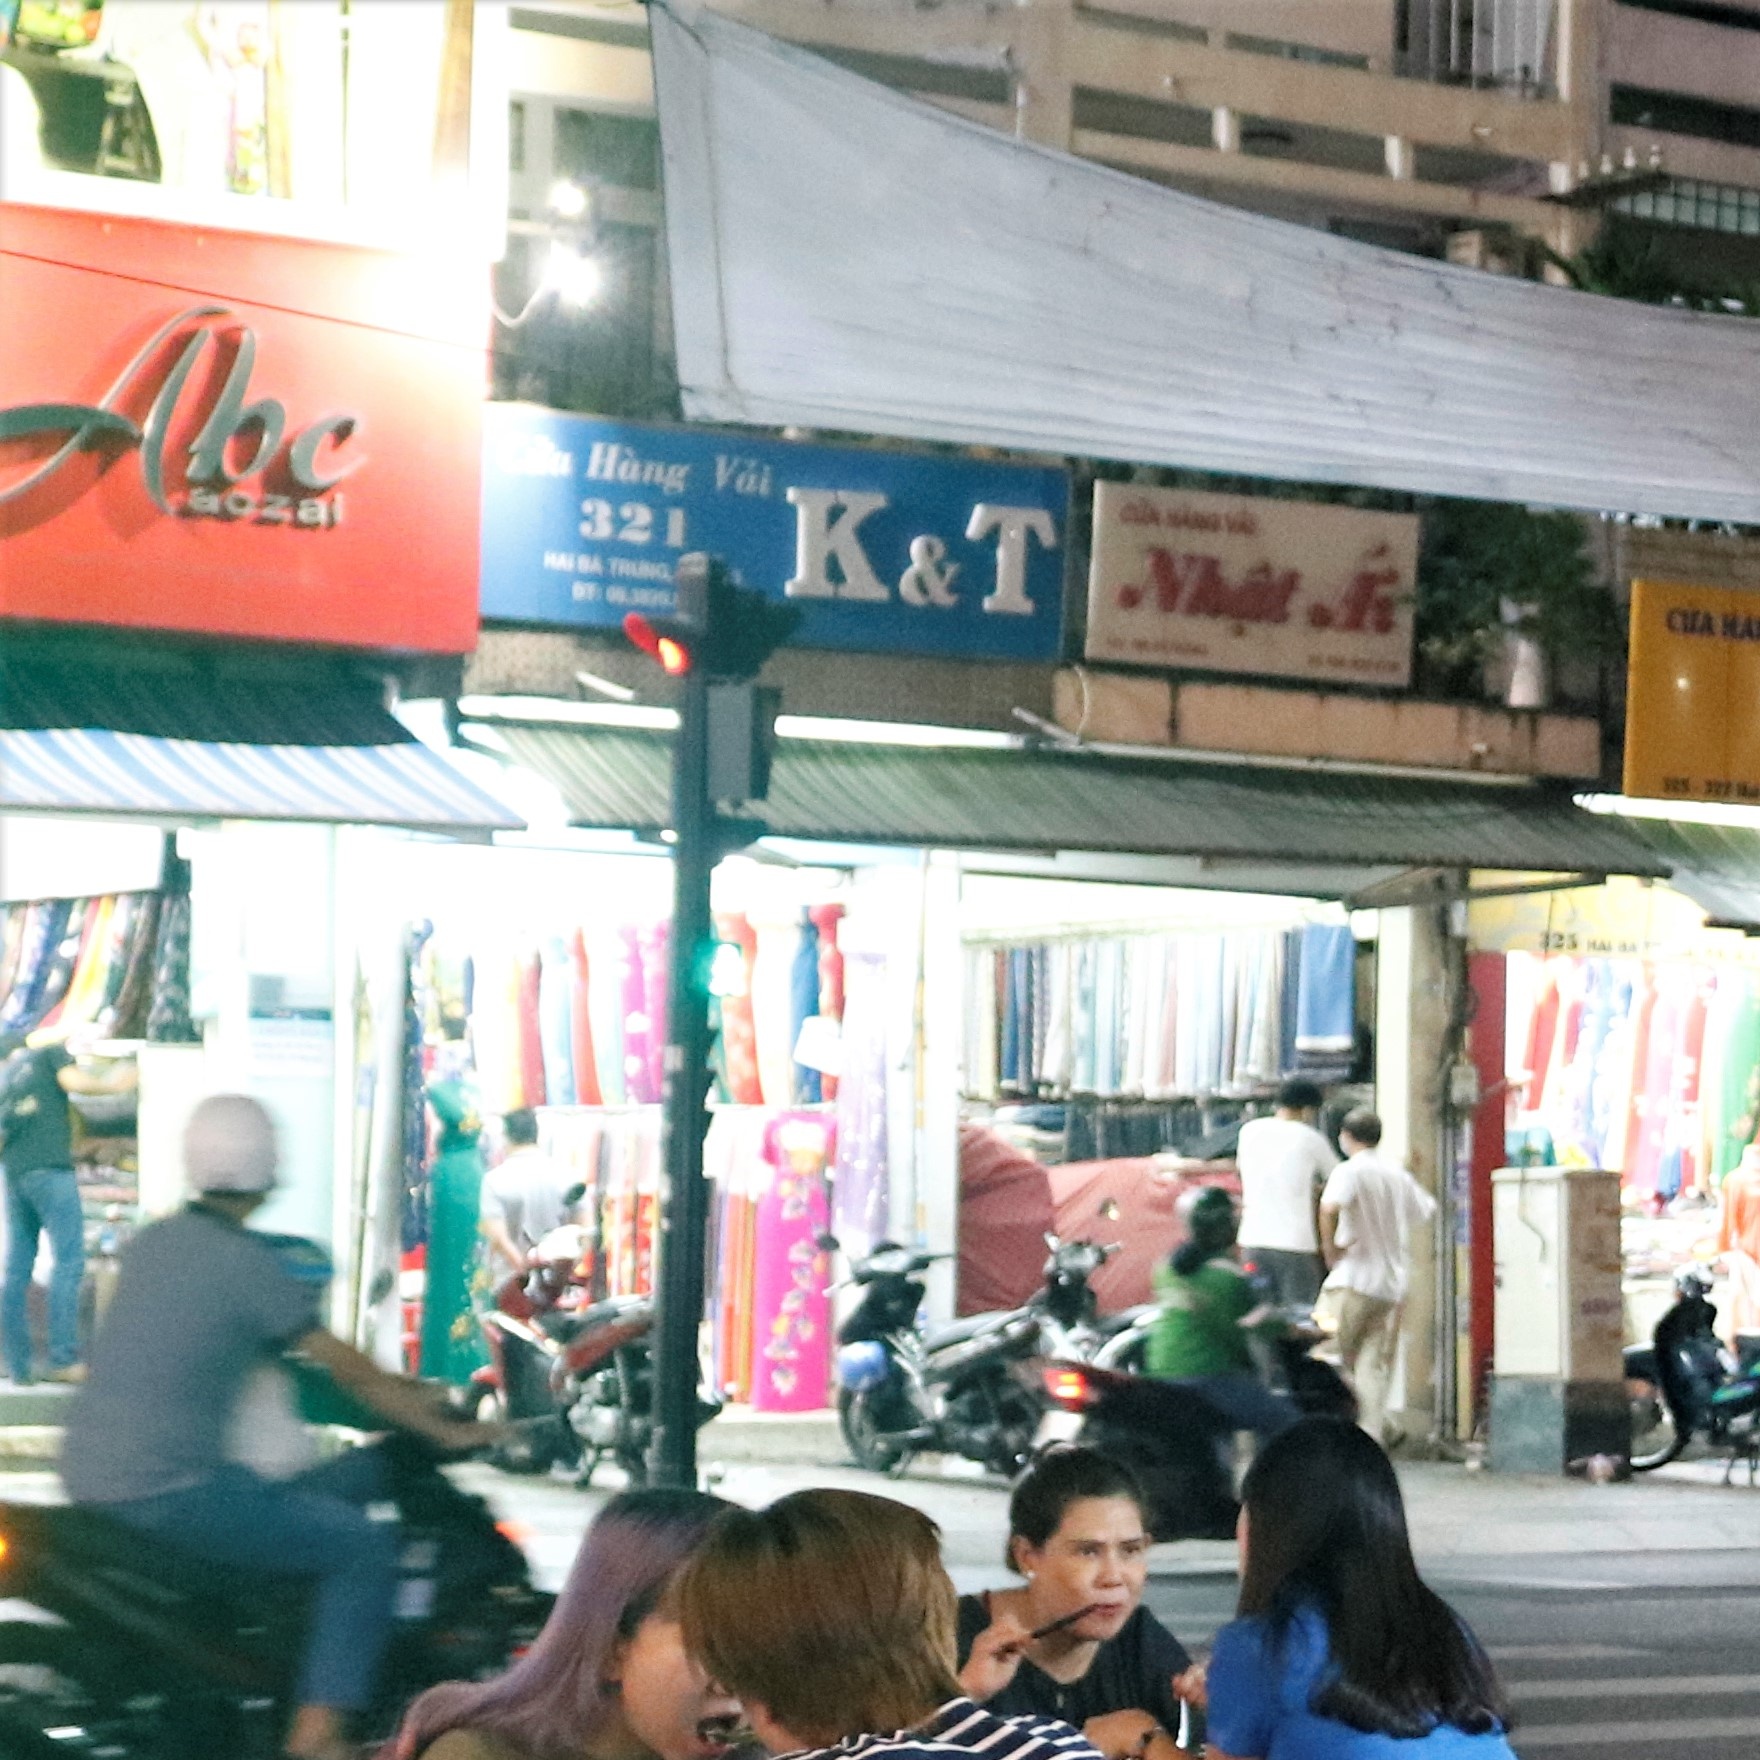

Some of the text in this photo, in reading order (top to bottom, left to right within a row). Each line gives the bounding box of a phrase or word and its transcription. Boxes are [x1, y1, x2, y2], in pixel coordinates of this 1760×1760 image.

[0, 304, 368, 520] Abc
[586, 442, 692, 494] Hàng
[713, 453, 771, 497] Vải
[579, 498, 686, 548] 321
[784, 486, 1055, 613] K & T
